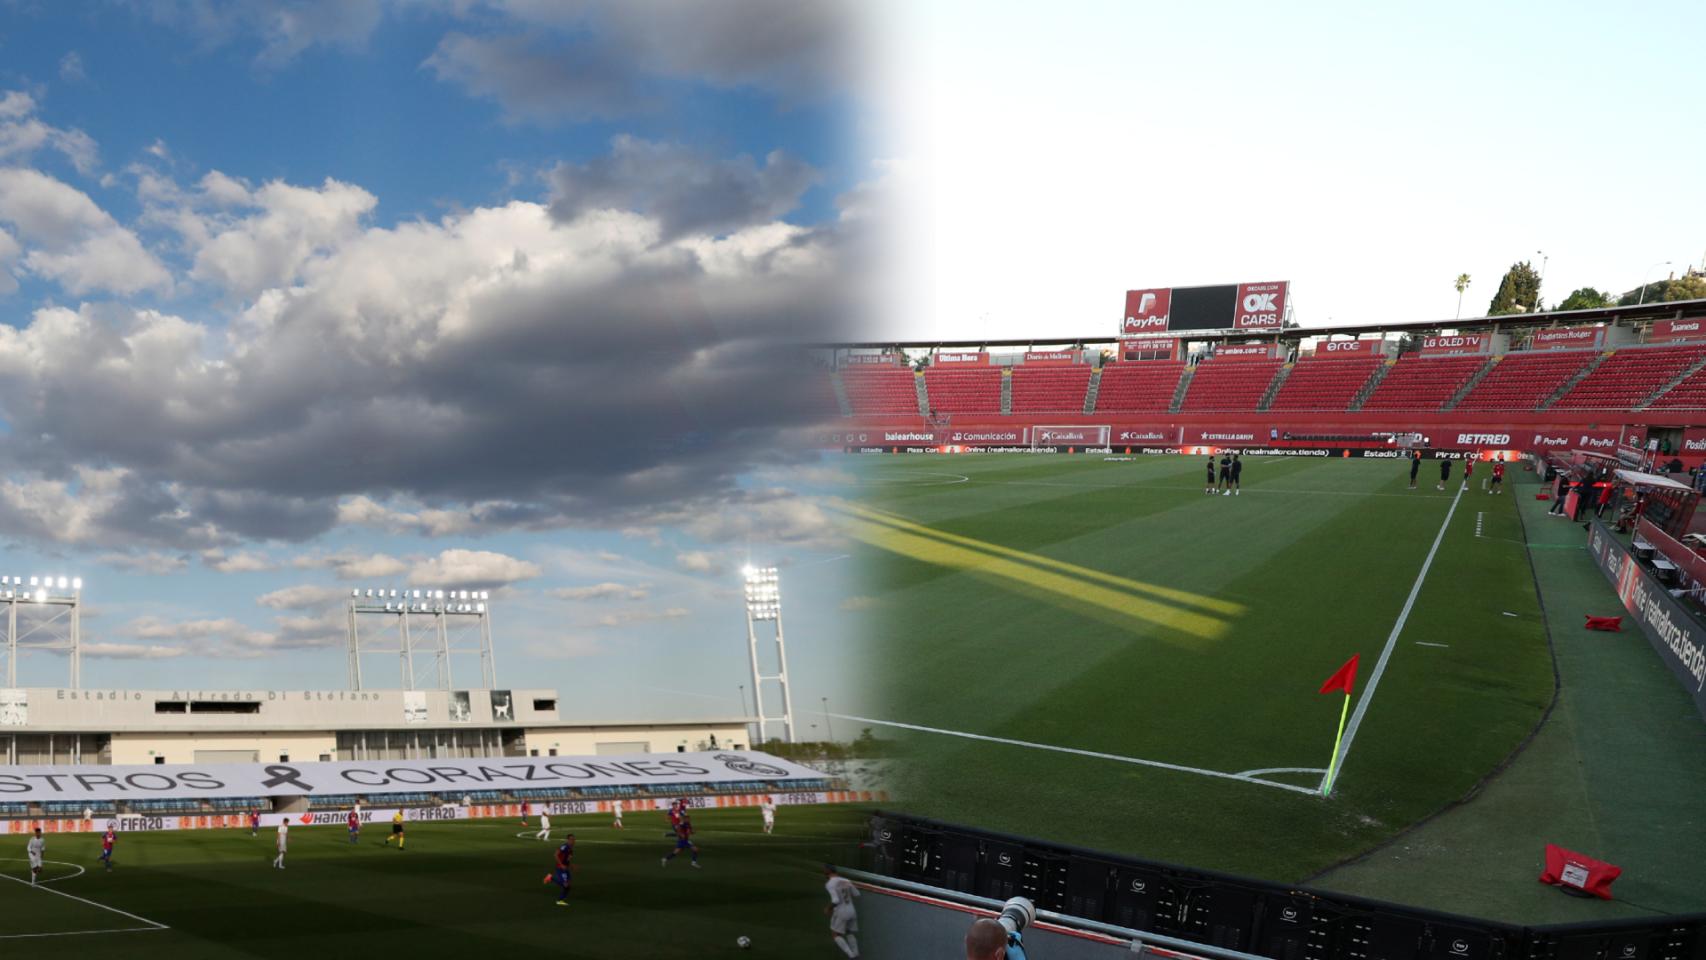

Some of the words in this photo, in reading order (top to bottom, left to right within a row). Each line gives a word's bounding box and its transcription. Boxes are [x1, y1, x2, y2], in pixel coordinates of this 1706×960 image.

[1243, 293, 1278, 312] OK
[1126, 315, 1168, 328] PayPal
[1241, 314, 1277, 325] CARS
[1423, 338, 1436, 348] LG
[1439, 337, 1464, 347] OLED
[1466, 336, 1480, 345] TV
[885, 432, 934, 441] balearhouse
[963, 432, 1017, 441] Comunicación
[1130, 431, 1164, 440] CaixaBank
[1457, 433, 1510, 445] BETFRED
[1543, 437, 1568, 446] PayPal
[1589, 438, 1614, 447] PayPal
[57, 689, 142, 700] Estadio
[172, 691, 253, 701] Alfredo
[268, 691, 287, 701] Di
[0, 772, 225, 793] STROS
[341, 760, 709, 786] CORAZONES
[420, 807, 456, 820] FIFA20
[553, 801, 586, 814] FIFA20
[120, 817, 163, 831] FIFA20
